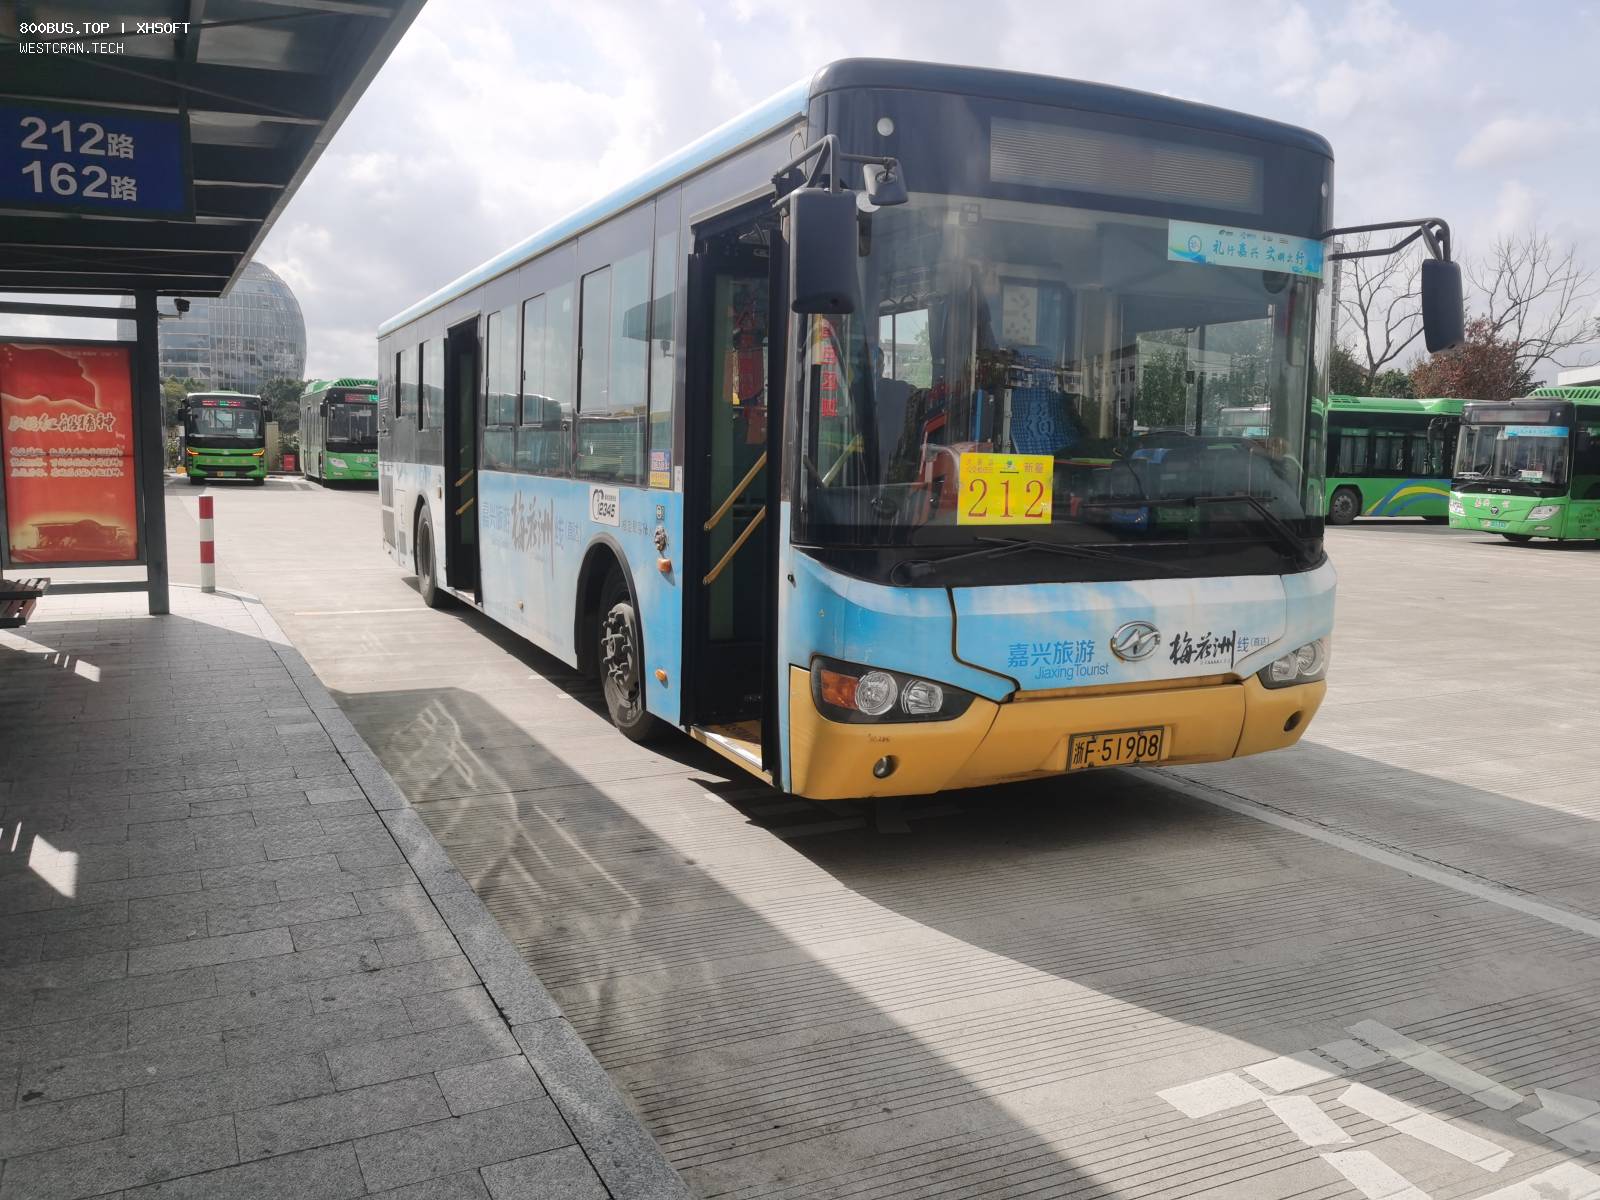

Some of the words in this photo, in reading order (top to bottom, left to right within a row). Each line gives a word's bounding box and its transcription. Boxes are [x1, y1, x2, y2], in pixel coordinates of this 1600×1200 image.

[20, 116, 135, 160] 212路
[22, 160, 137, 202] 162路
[967, 478, 1045, 519] 212
[1007, 639, 1097, 668] 嘉兴旅游
[1035, 664, 1074, 681] Jiaxing
[1075, 663, 1110, 677] Tourist
